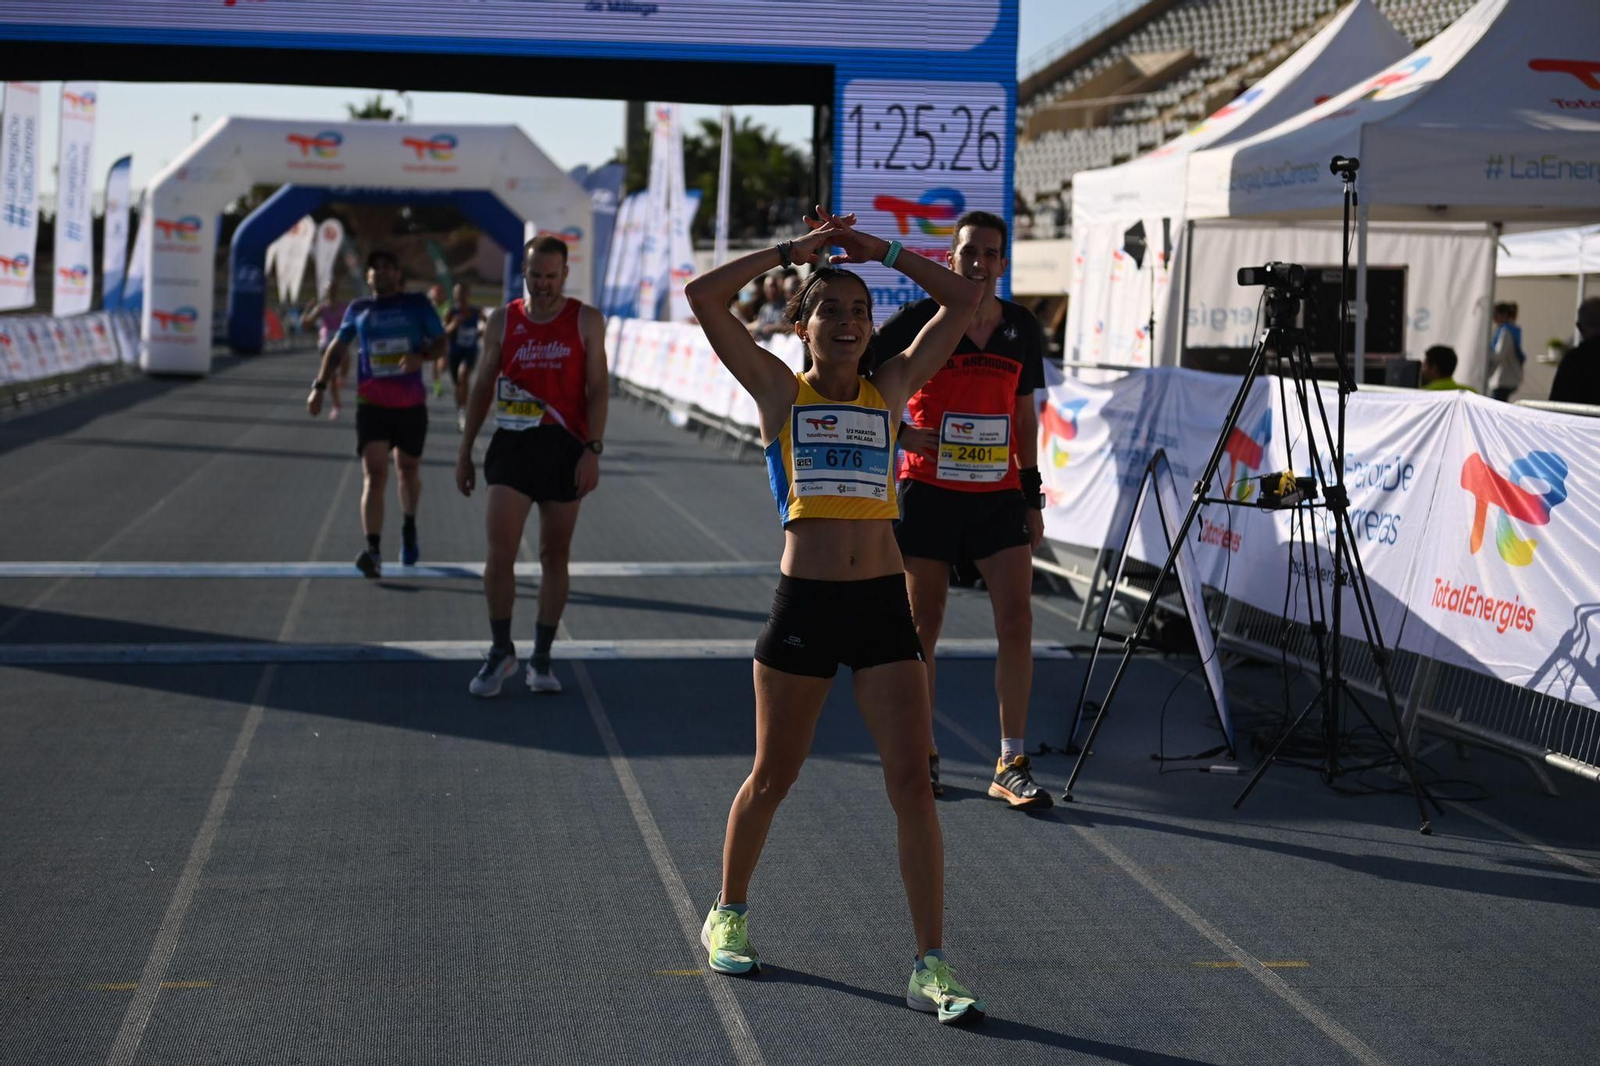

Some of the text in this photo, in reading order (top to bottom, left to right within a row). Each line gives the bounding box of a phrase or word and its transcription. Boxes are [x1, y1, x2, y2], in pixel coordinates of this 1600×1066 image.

[849, 103, 1001, 172] 1:25:26
[826, 449, 862, 467] 676
[958, 447, 992, 461] 2401
[1431, 578, 1537, 634] TotalEnergies
